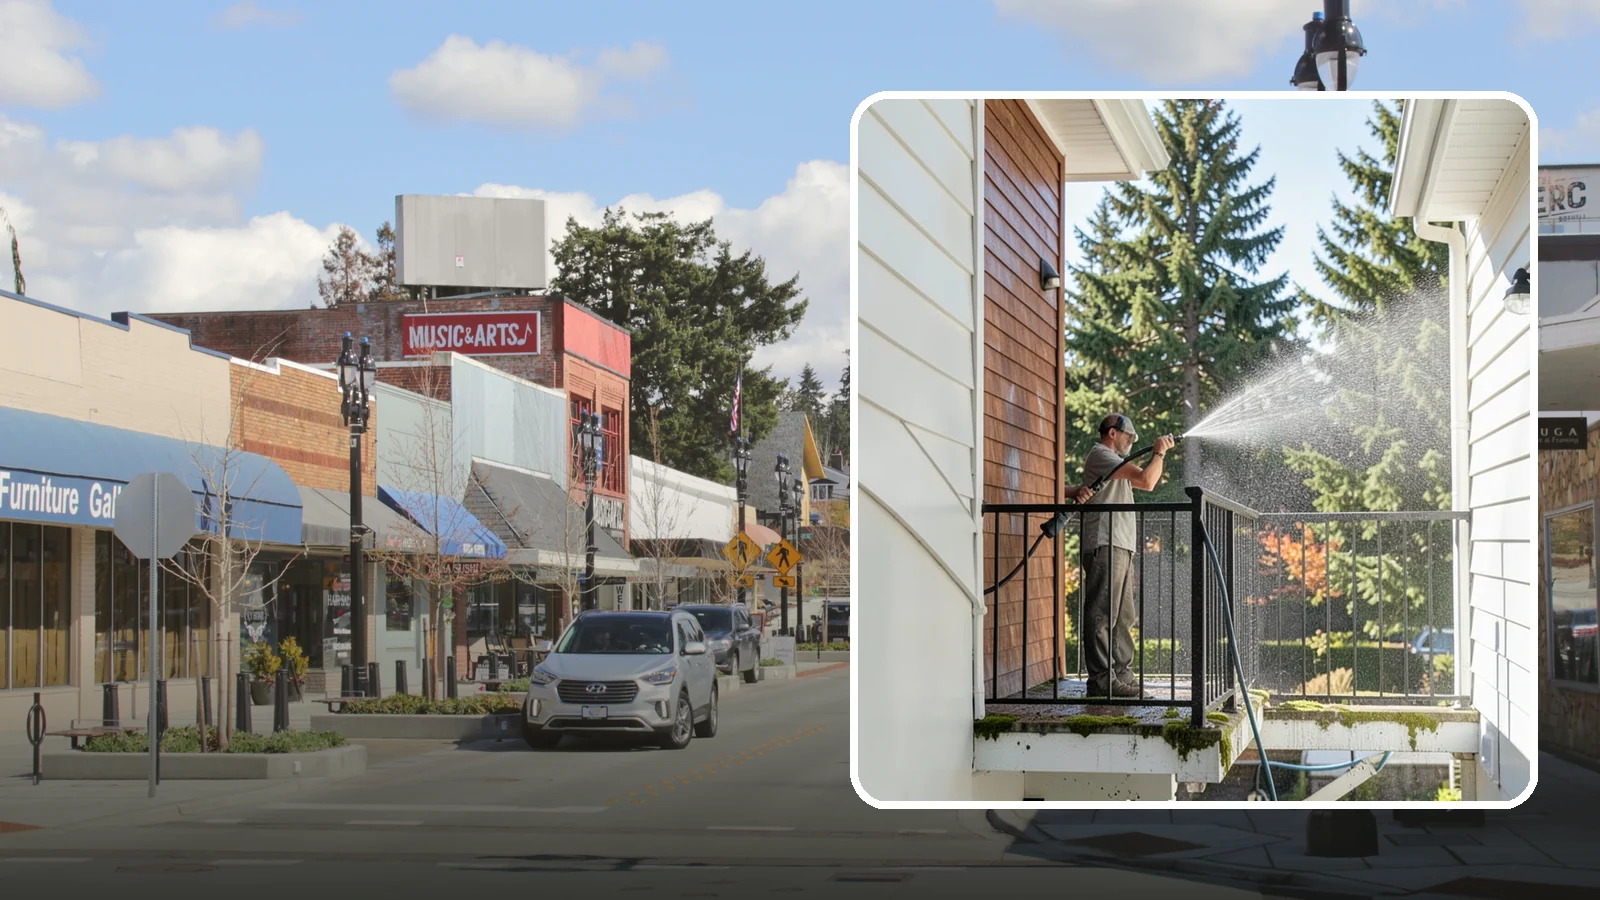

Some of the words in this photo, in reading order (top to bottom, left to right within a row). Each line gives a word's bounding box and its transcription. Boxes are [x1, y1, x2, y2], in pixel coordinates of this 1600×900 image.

[408, 323, 520, 349] MUSIC&ARTS
[1540, 427, 1578, 436] UGA
[0, 471, 79, 515] Furniture
[89, 482, 122, 519] Gal
